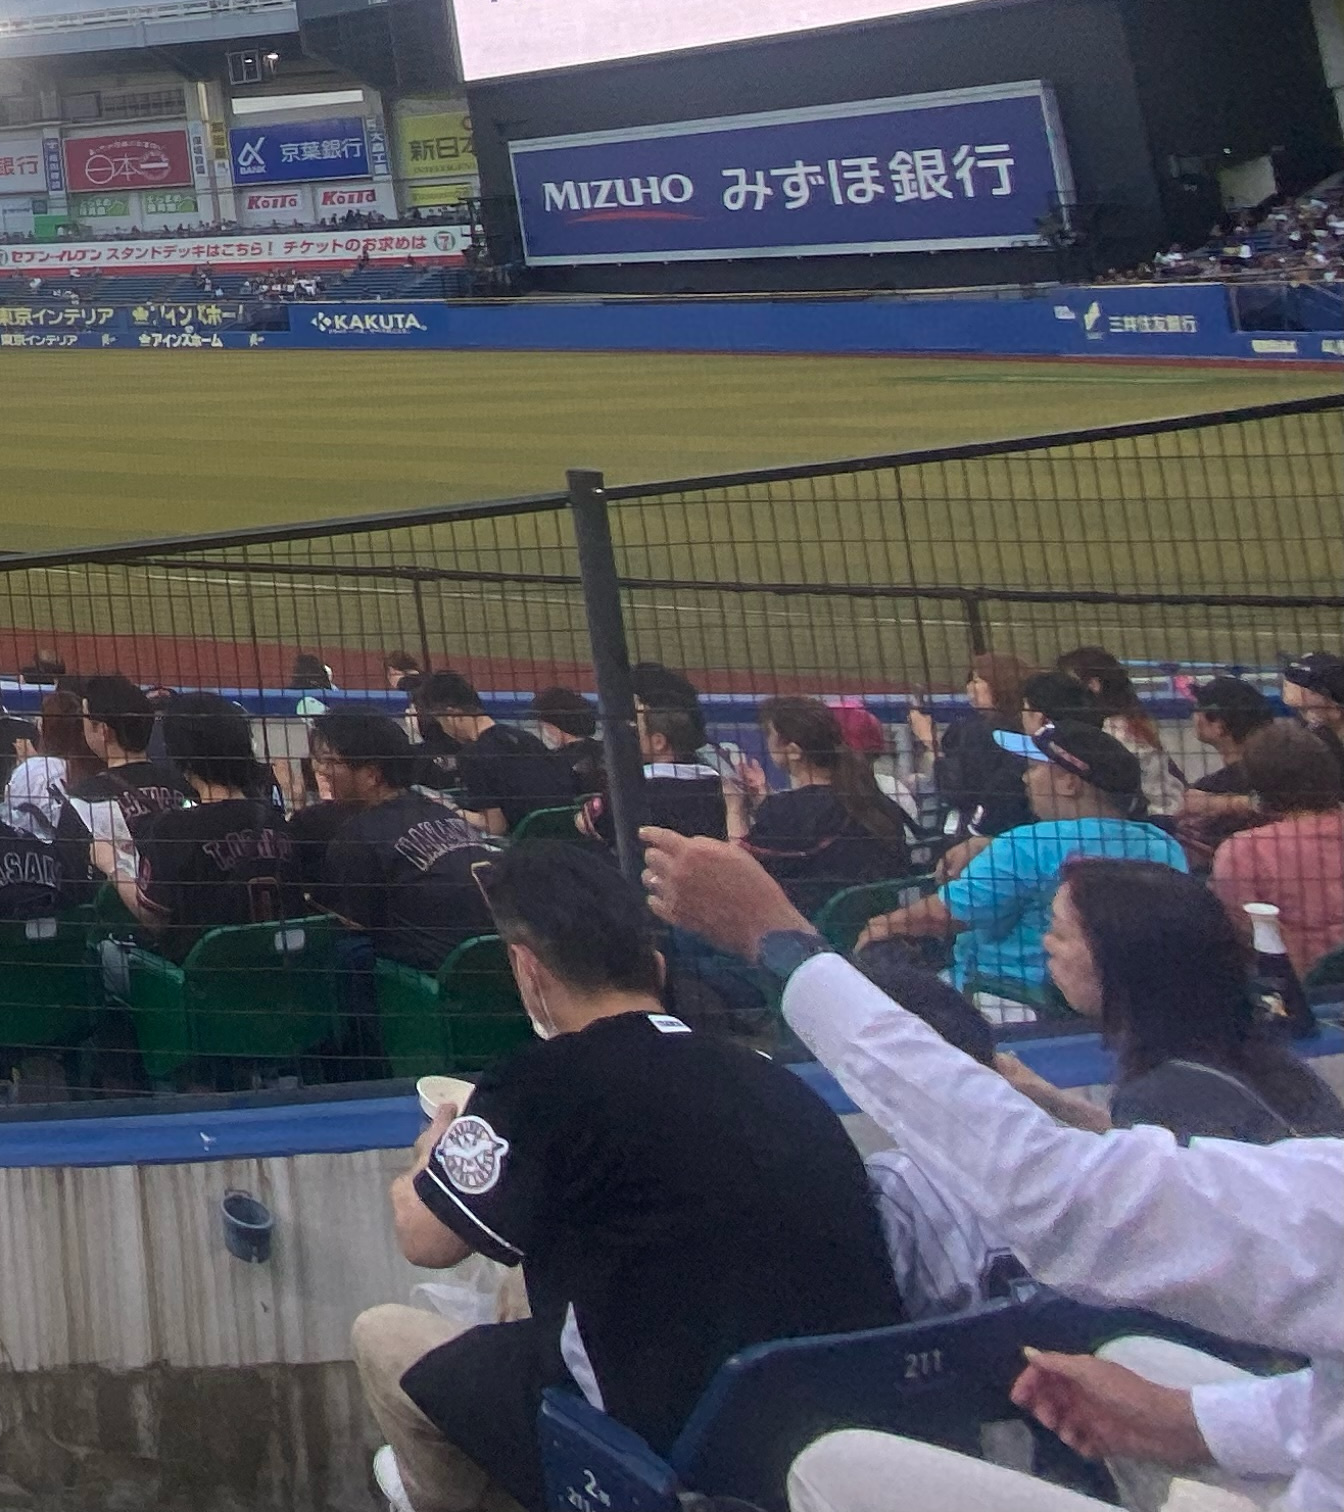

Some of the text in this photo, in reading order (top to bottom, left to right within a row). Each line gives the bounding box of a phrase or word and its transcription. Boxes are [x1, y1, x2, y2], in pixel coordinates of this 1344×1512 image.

[279, 137, 363, 163] 京葉銀行
[542, 143, 1015, 212] MIZUHO みずほ銀行
[283, 235, 427, 255] チケットのお求めは
[333, 312, 424, 330] KAKUTA
[0, 334, 78, 346] 東京インテリア
